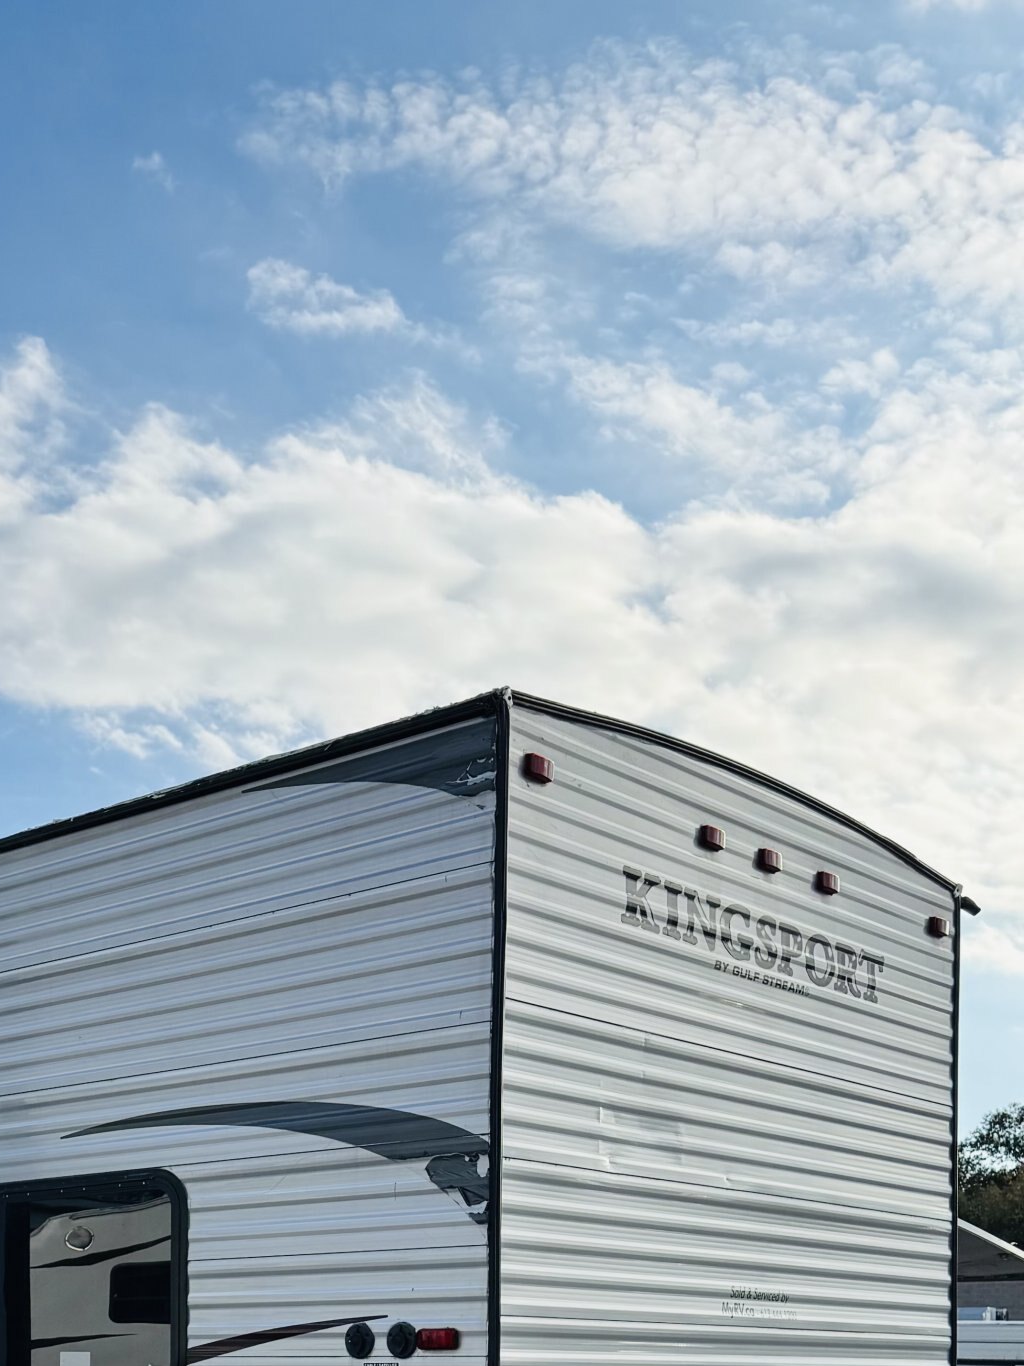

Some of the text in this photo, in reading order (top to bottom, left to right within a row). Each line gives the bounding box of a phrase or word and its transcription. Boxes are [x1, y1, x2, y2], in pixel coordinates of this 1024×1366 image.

[621, 865, 885, 1004] KINGSPORT
[714, 960, 729, 973] BY
[732, 966, 760, 982] GULF
[730, 1285, 746, 1299] Sold
[753, 1288, 780, 1302] Serviced
